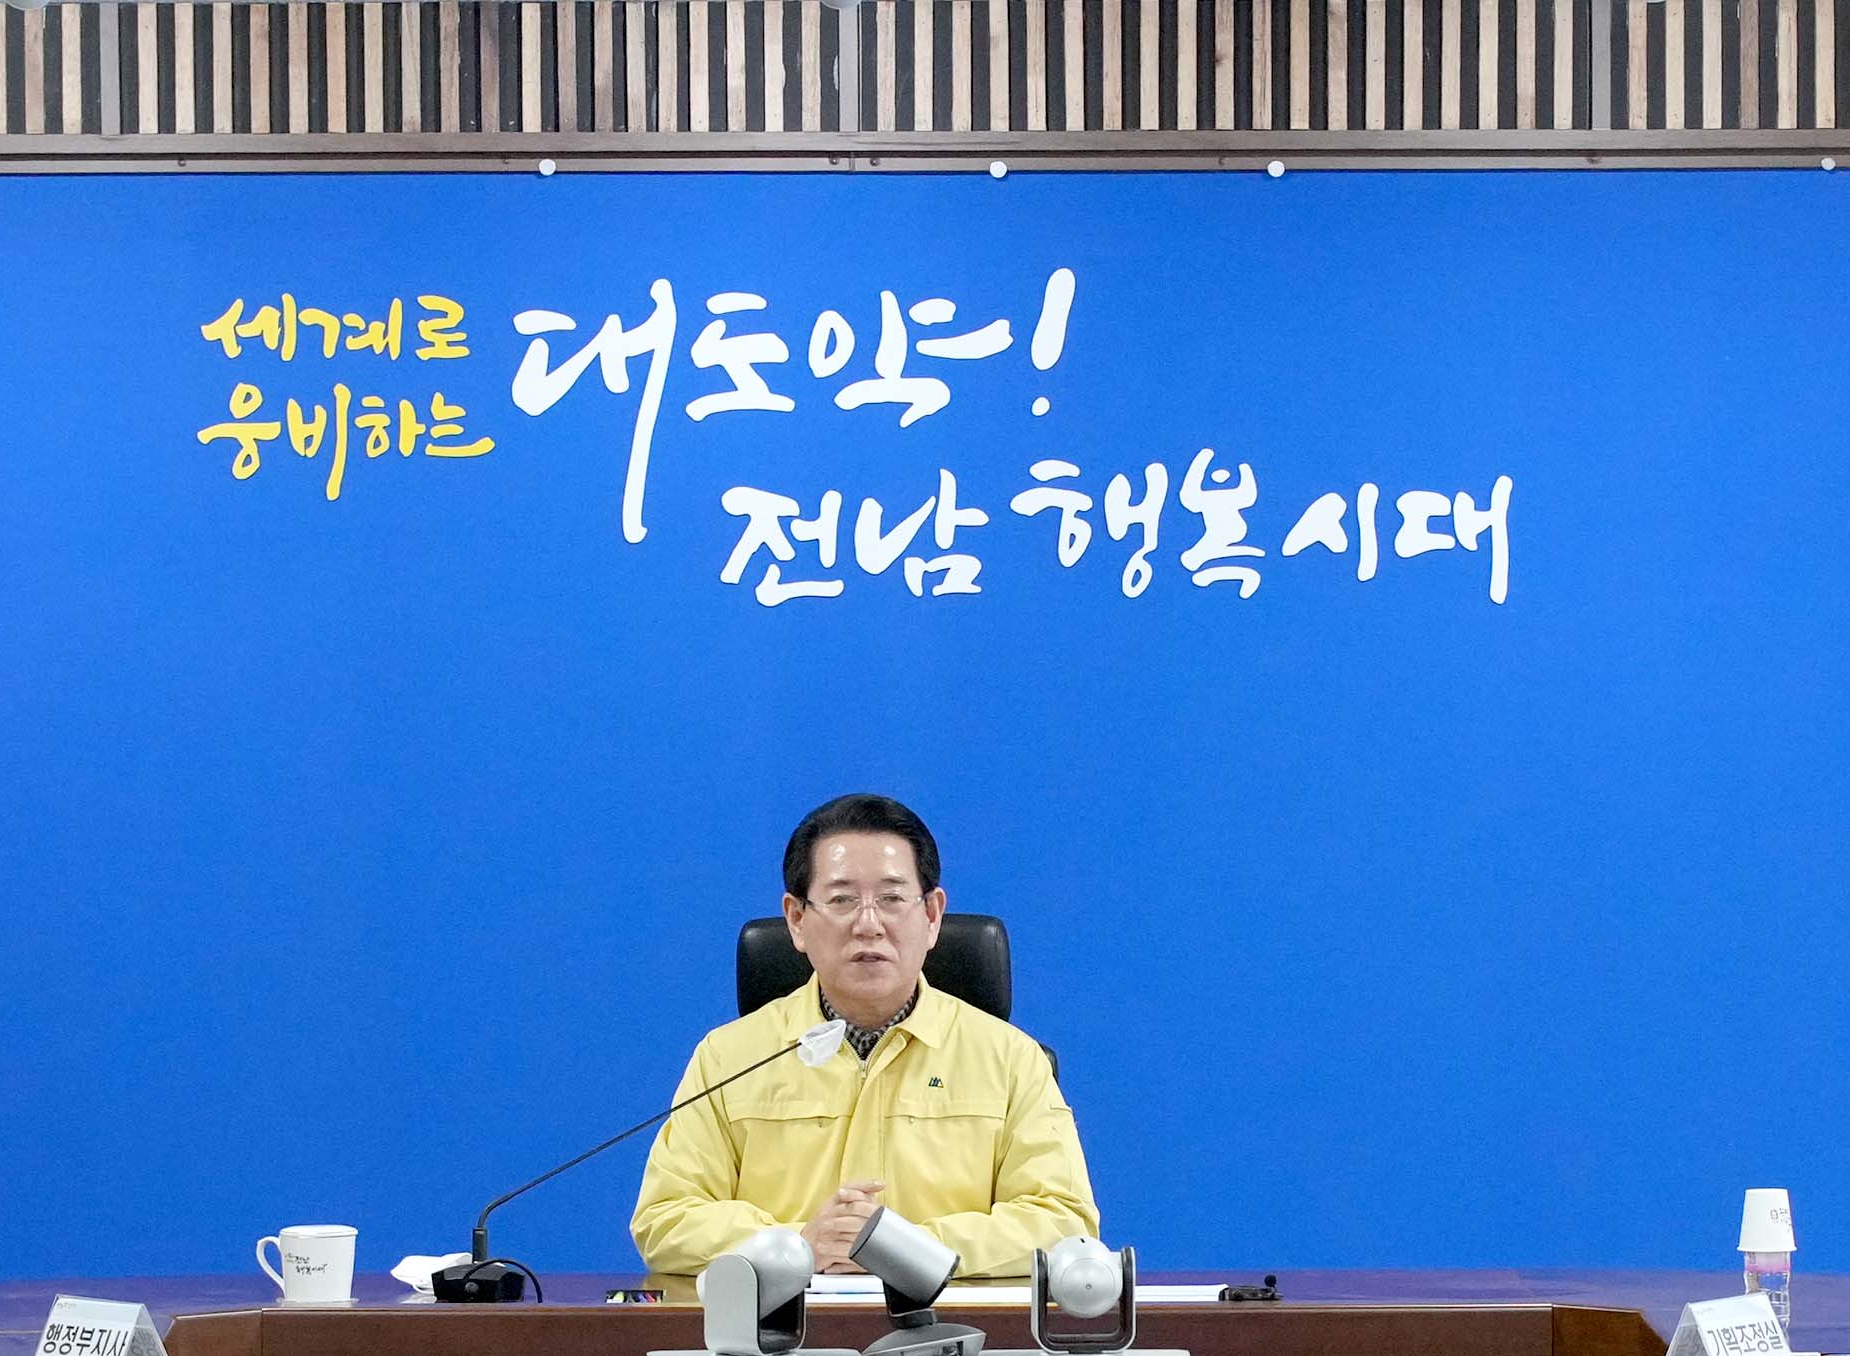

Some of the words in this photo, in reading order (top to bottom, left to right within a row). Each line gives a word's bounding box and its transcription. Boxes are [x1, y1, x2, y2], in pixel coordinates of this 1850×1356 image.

[199, 291, 473, 363] 세계로
[195, 382, 497, 502] 웅비하는
[511, 267, 1077, 545] 대도약!
[719, 467, 991, 608] 전남
